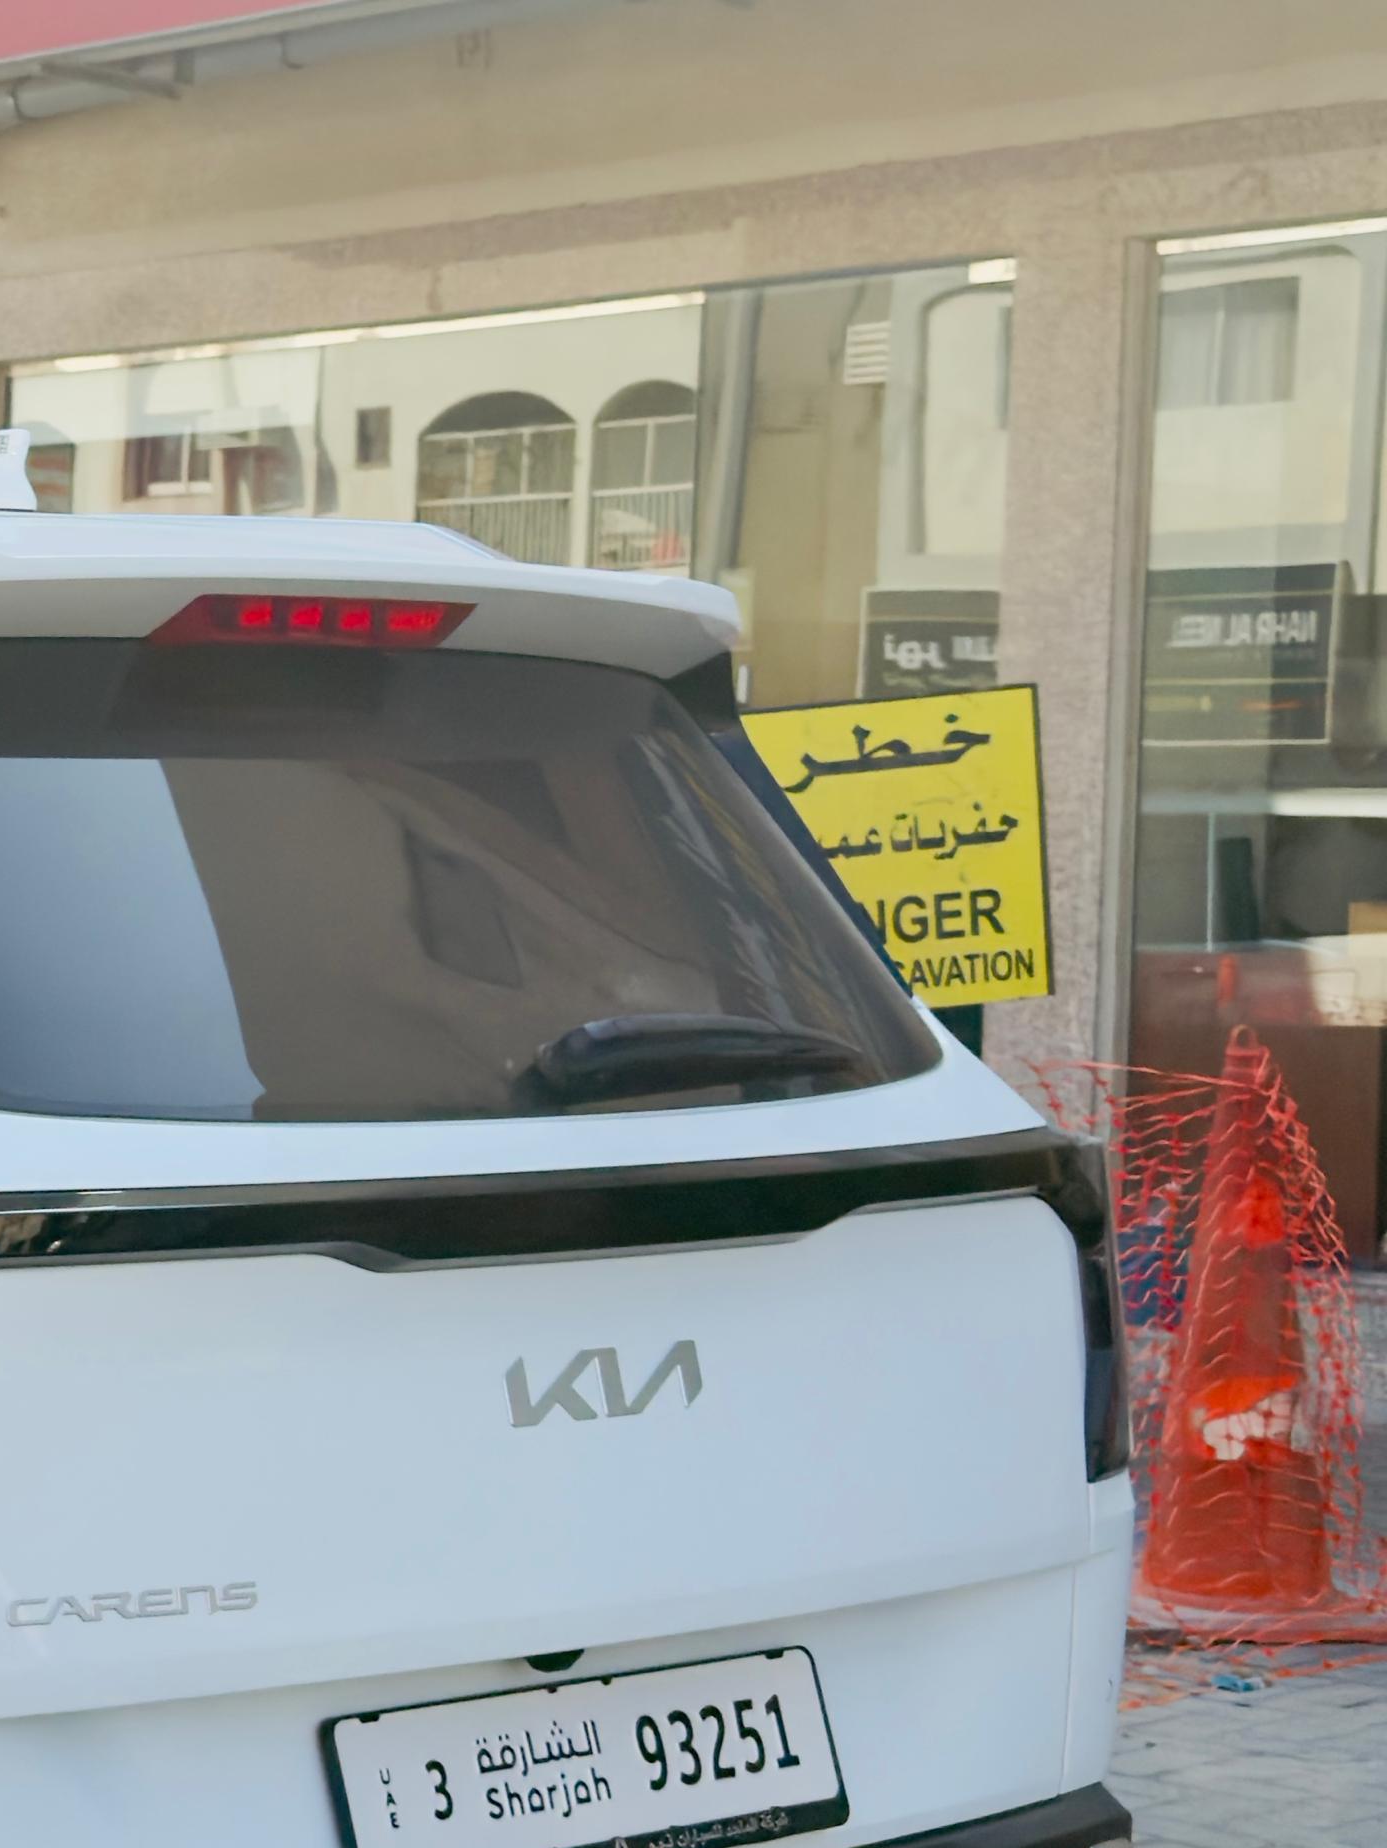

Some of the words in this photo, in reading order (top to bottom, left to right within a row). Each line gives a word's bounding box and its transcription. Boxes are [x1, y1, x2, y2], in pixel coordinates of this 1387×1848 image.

[782, 713, 992, 793] خطر
[890, 801, 1019, 861] حفريات
[859, 888, 1005, 944] NGER
[504, 1338, 703, 1428] KIA
[5, 1581, 258, 1628] CARENS
[474, 1719, 602, 1777] الشارقة
[635, 1694, 800, 1791] 93251
[426, 1760, 454, 1820] 3
[485, 1767, 613, 1820] Sharjah
